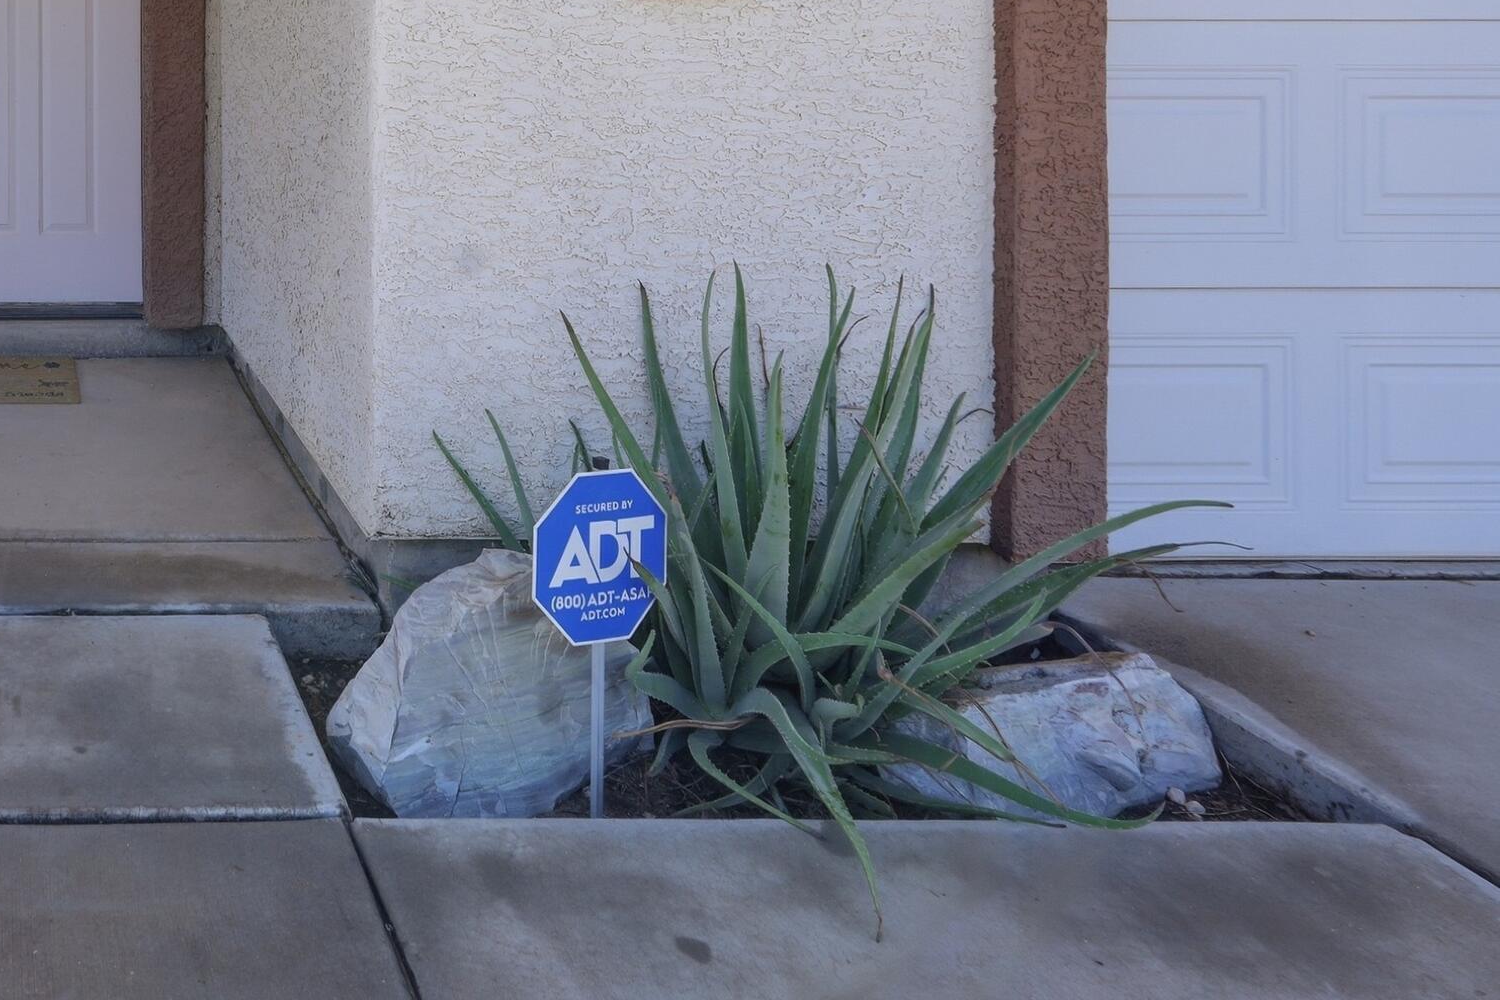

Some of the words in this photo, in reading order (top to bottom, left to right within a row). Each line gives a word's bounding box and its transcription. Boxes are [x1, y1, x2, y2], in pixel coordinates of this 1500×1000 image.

[575, 501, 619, 515] SECURED
[621, 500, 634, 510] BY
[549, 515, 655, 588] ADT
[551, 593, 586, 613] (800)
[580, 607, 626, 622] ADT.COM
